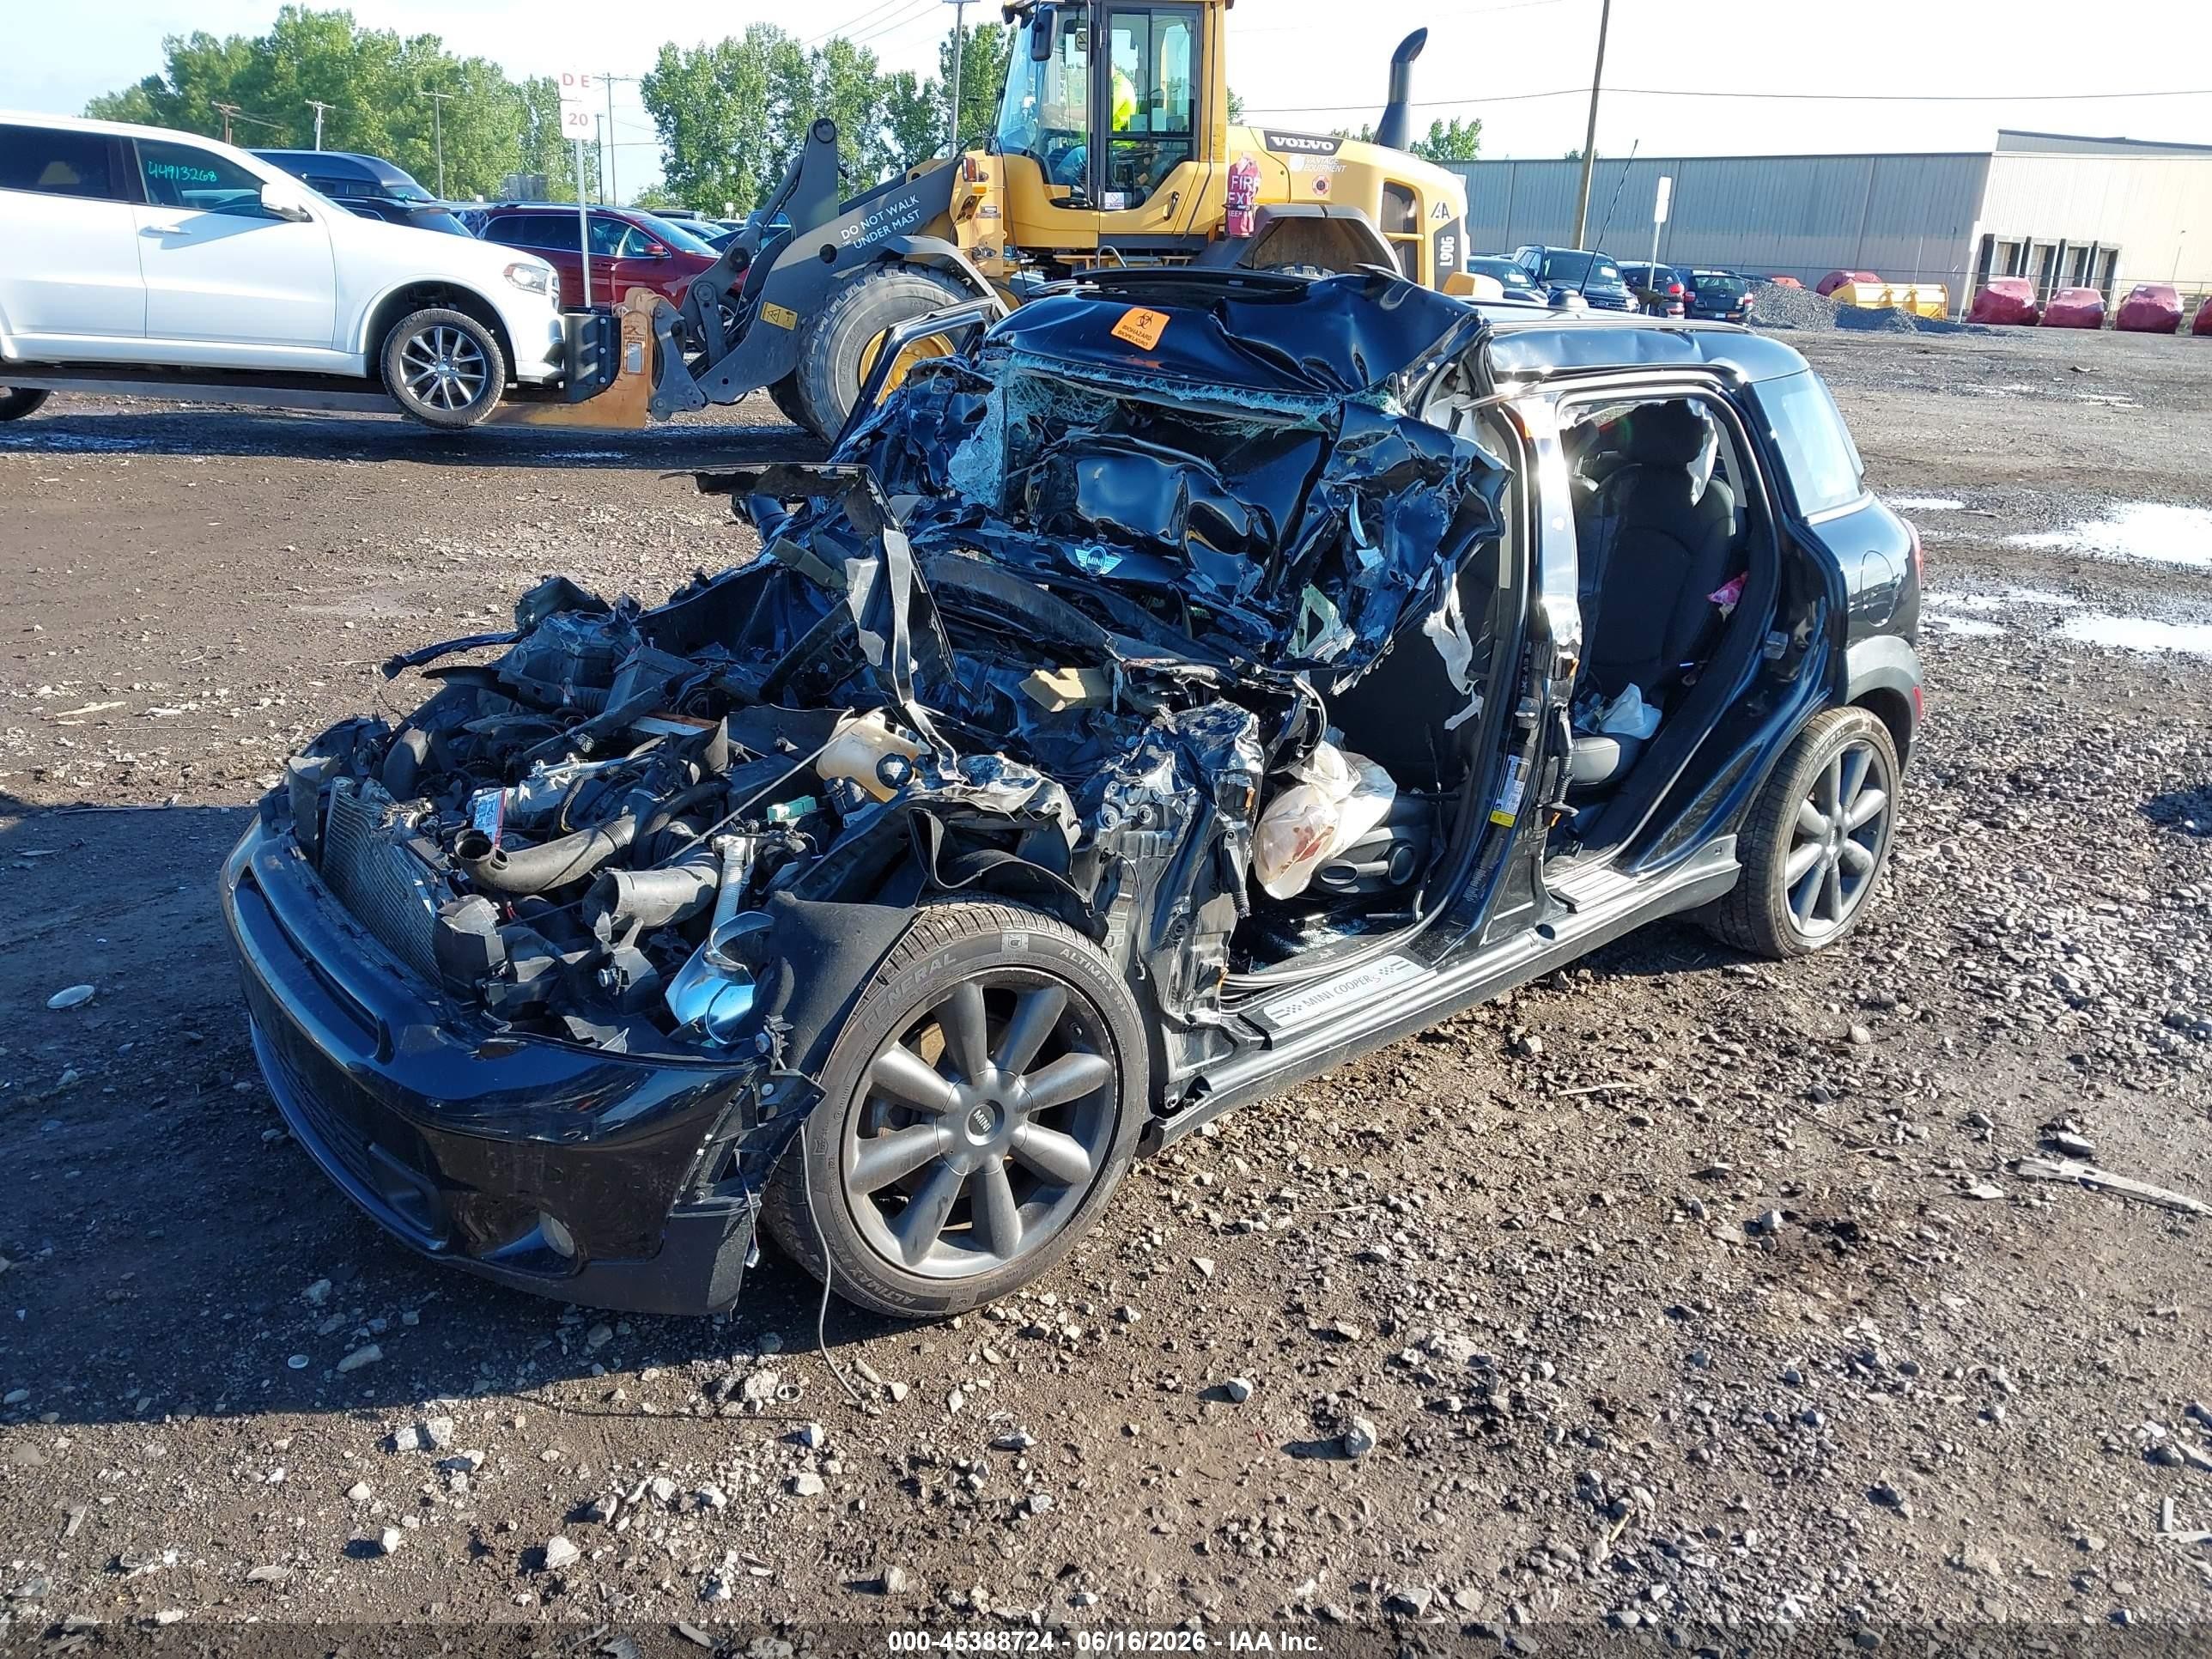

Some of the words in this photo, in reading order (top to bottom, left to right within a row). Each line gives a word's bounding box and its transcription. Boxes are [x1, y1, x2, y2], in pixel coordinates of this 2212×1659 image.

[568, 112, 588, 126] 20
[1271, 136, 1334, 151] VOLVO
[147, 161, 217, 182] 44913268
[841, 225, 859, 240] DO
[860, 211, 884, 230] NOT
[885, 194, 920, 216] WALK
[853, 226, 891, 249] UNDER
[891, 209, 920, 230] MAST
[1439, 235, 1455, 266] L90G
[1121, 325, 1152, 341] BIOHAZARD
[1086, 555, 1103, 568] MINI
[1060, 948, 1115, 993] ALTIMAX
[863, 953, 957, 1031] GENERAL
[1302, 991, 1334, 1007] MINI
[1334, 975, 1374, 995] COOPER
[973, 1109, 992, 1132] MINI
[848, 1266, 916, 1305] ALTIMAX
